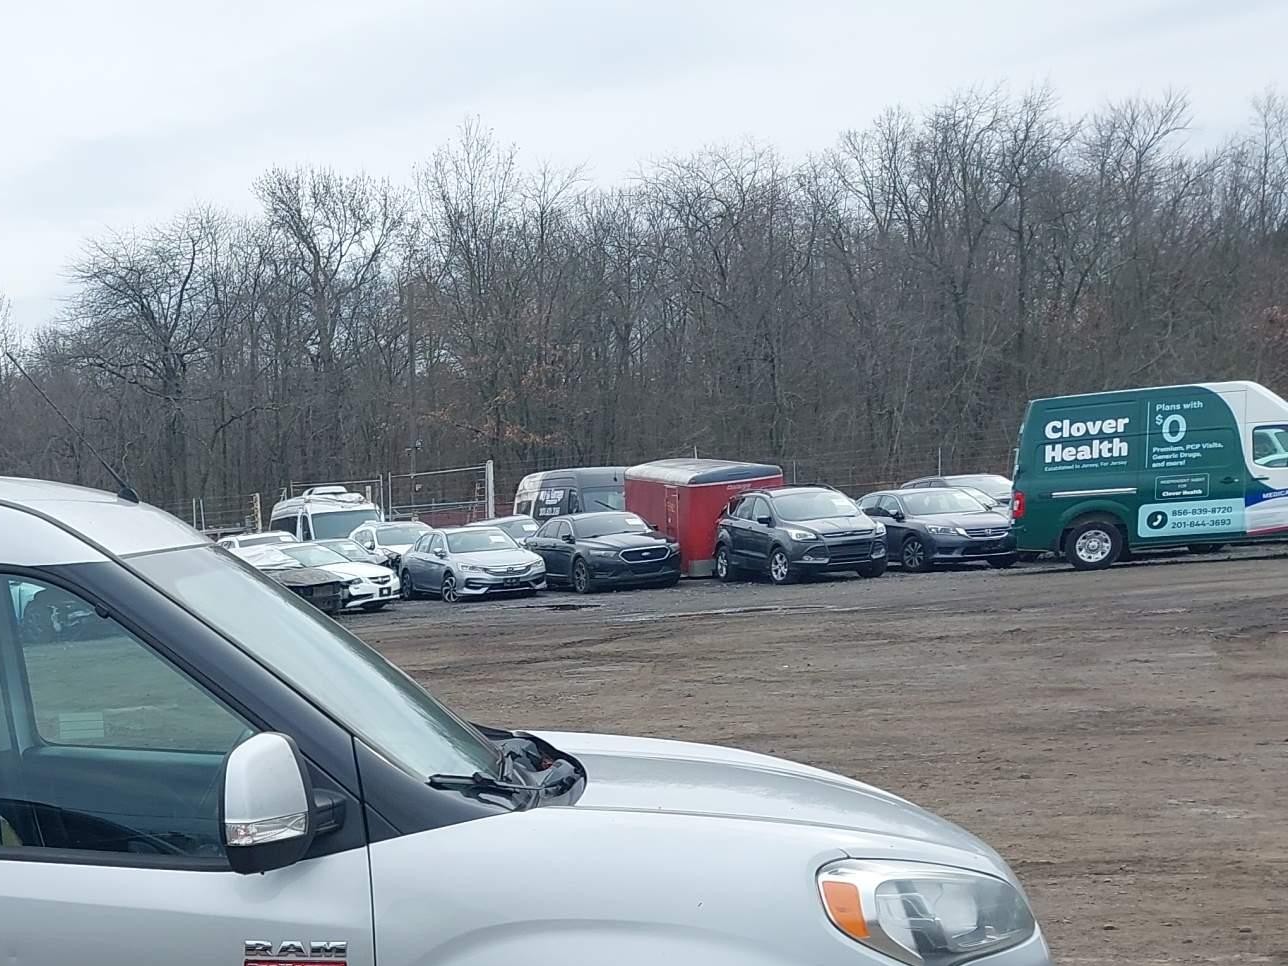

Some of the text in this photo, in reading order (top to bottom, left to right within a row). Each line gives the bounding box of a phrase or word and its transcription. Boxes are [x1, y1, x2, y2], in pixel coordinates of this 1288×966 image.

[1155, 400, 1204, 411] Plans with
[1044, 417, 1129, 439] Clover
[1155, 413, 1187, 443] $0
[1044, 437, 1128, 464] Health
[1186, 443, 1201, 451] PCP
[1151, 460, 1165, 468] and
[245, 940, 347, 958] RAM
